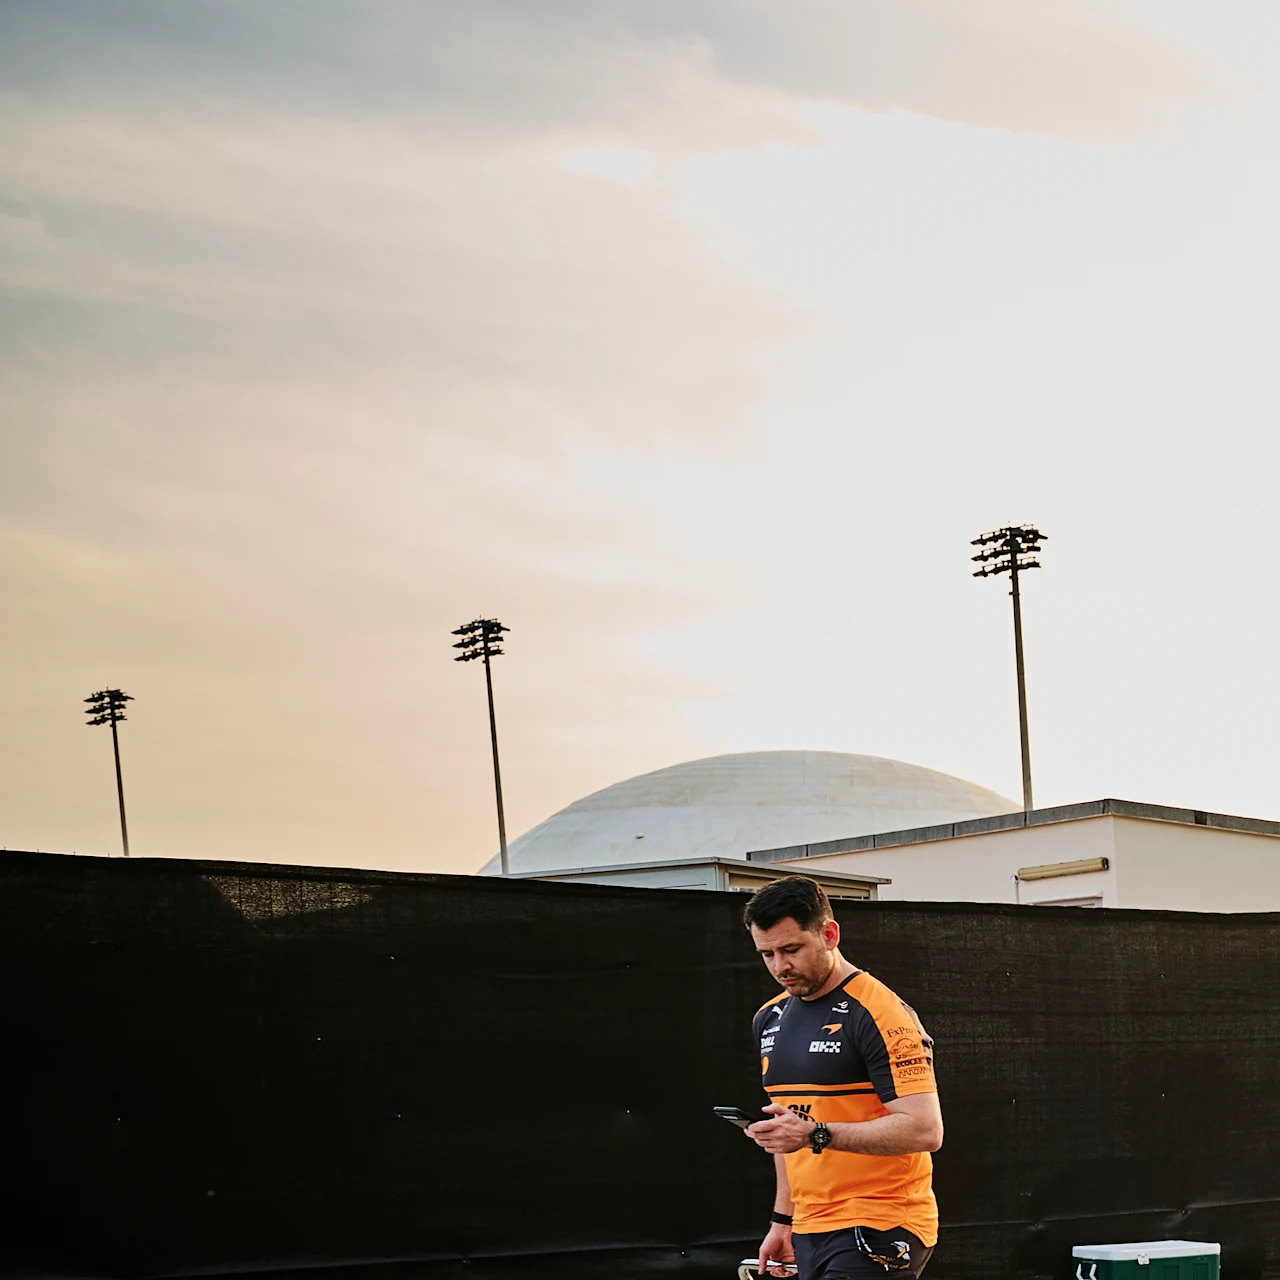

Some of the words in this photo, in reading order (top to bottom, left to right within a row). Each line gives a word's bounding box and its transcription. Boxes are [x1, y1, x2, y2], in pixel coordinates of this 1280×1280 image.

[886, 1026, 914, 1038] FxPro
[808, 1041, 842, 1053] OKX
[895, 1058, 923, 1068] ECOLAB
